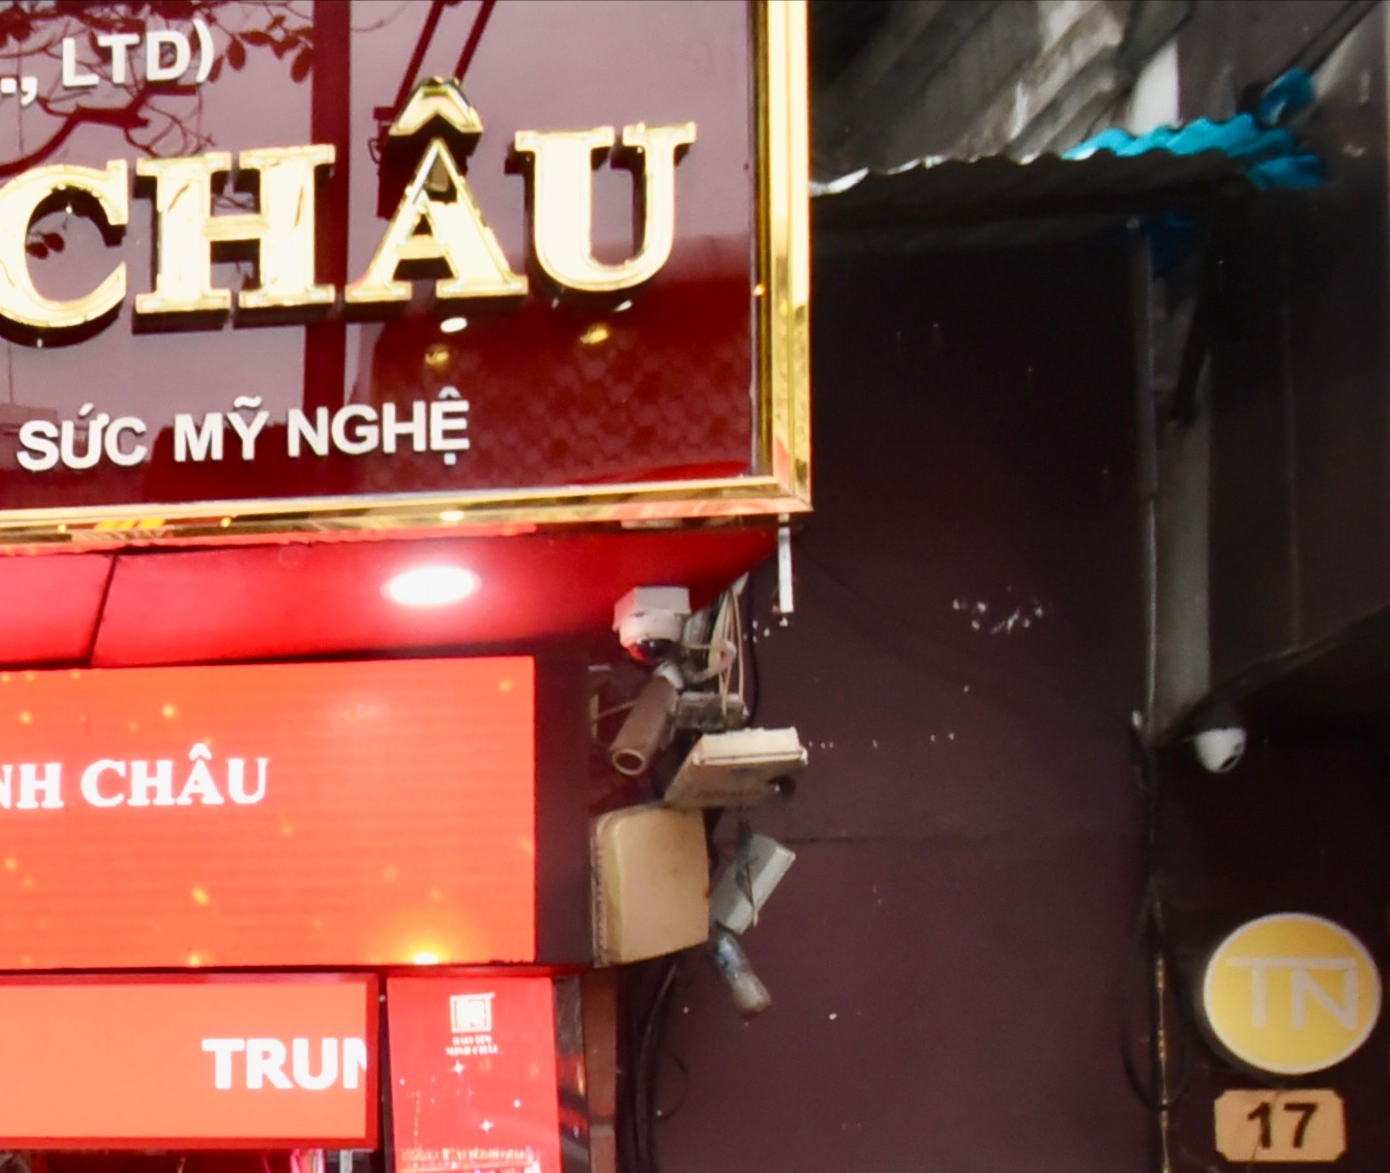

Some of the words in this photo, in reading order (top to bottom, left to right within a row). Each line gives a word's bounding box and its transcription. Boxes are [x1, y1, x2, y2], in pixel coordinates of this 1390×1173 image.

[62, 20, 215, 88] LTD)
[17, 402, 148, 472] SỨC
[174, 396, 270, 462] MỸ
[287, 386, 470, 466] NGHỆ
[80, 743, 270, 808] CHÂU
[1227, 955, 1362, 1031] TN
[1247, 1101, 1319, 1150] 17
